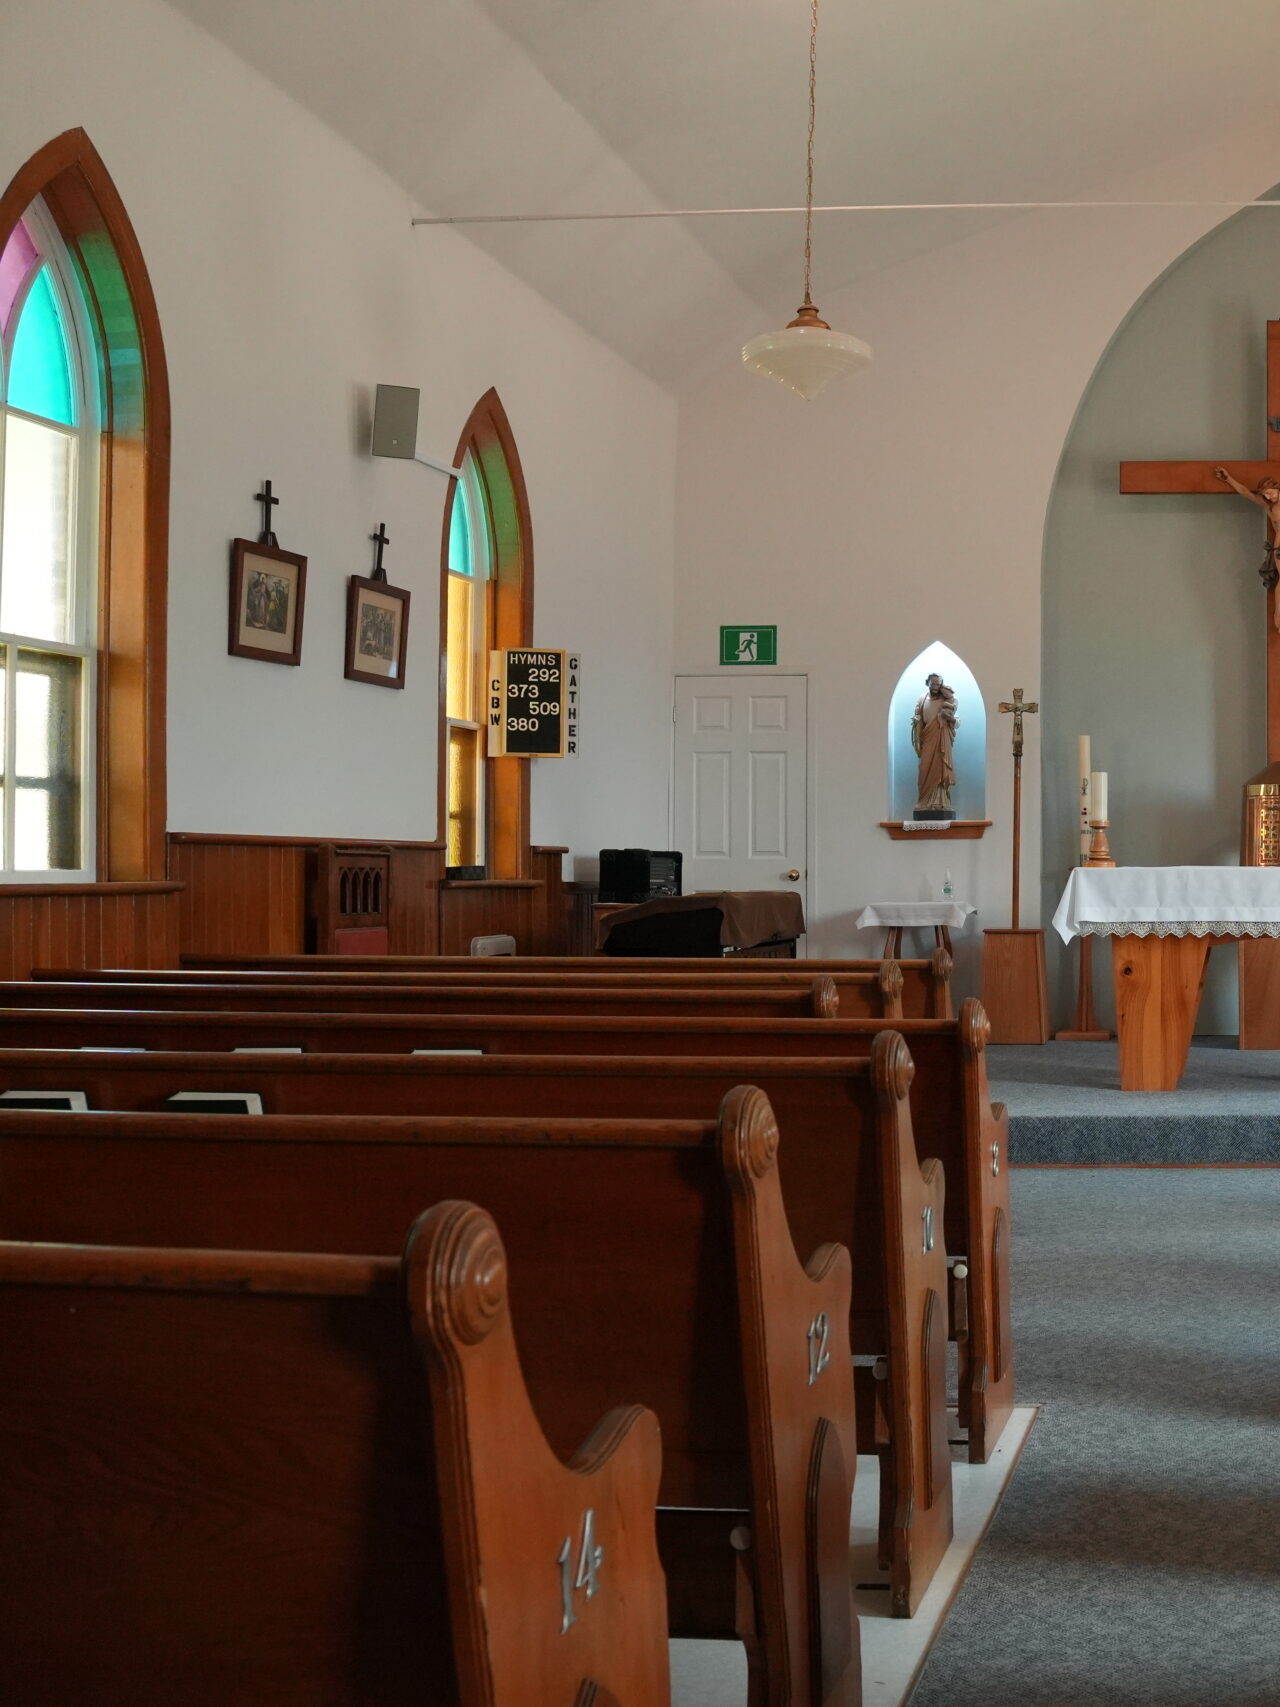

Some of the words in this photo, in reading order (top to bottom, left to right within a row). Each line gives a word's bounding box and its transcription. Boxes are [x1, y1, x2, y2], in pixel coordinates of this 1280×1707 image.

[510, 653, 556, 666] HYMNS
[528, 668, 559, 682] 292
[508, 684, 539, 698] 373
[490, 680, 500, 726] CBW
[529, 701, 559, 715] 509
[568, 658, 578, 753] GATHER
[507, 717, 539, 731] 380
[807, 1311, 831, 1386] 12
[557, 1508, 603, 1635] 14
